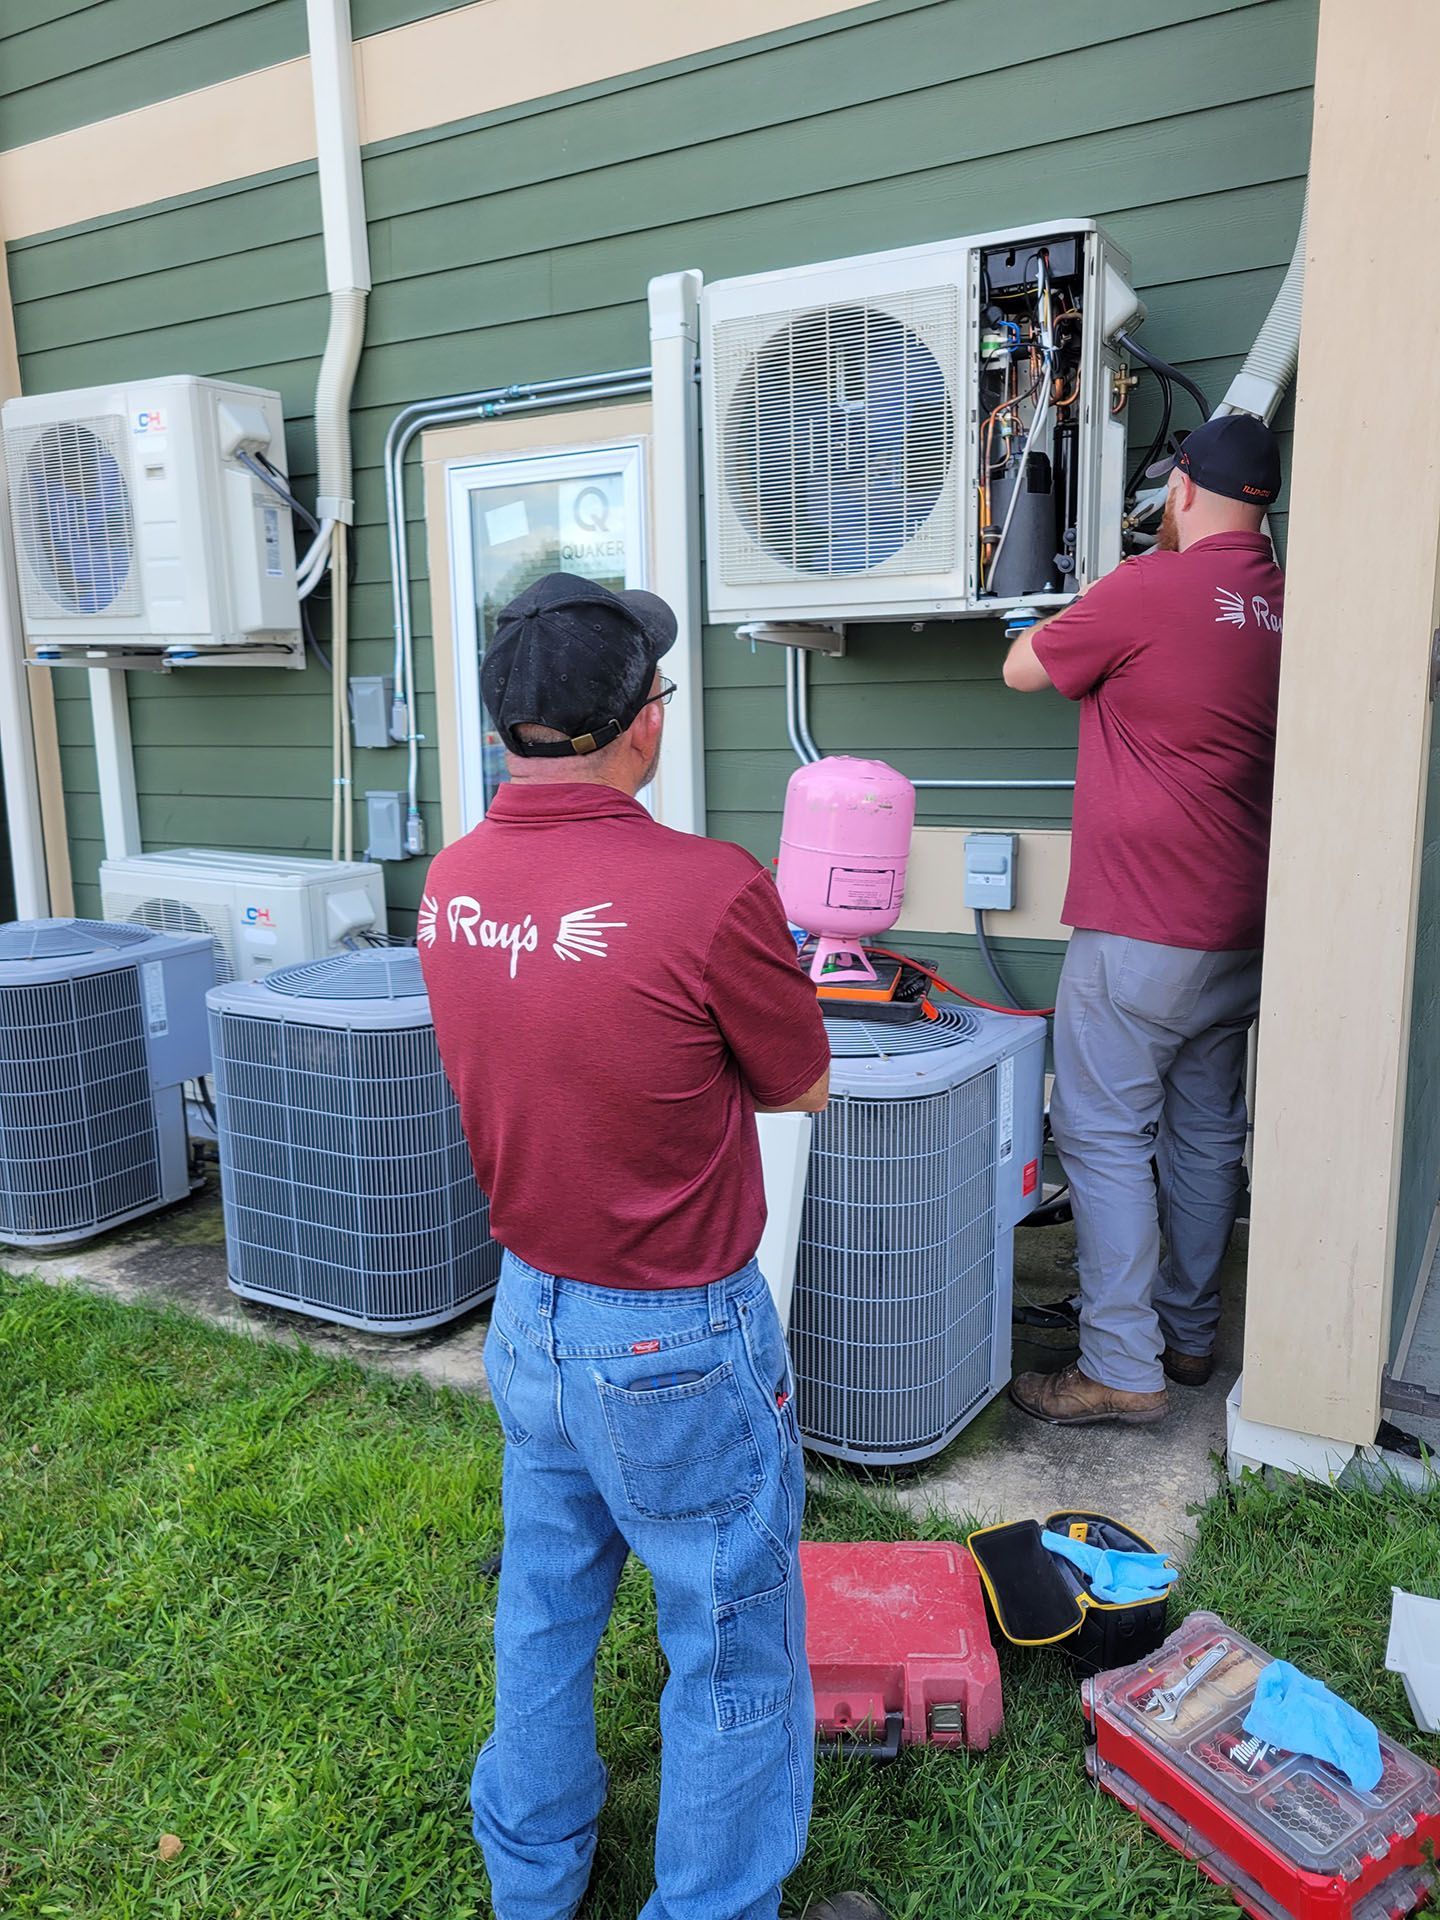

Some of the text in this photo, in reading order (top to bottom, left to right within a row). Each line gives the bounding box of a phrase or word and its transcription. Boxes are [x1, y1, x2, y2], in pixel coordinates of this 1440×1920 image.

[574, 486, 610, 532] Q
[562, 540, 625, 560] QUAKER
[246, 907, 270, 921] CH
[447, 896, 538, 979] Ray's
